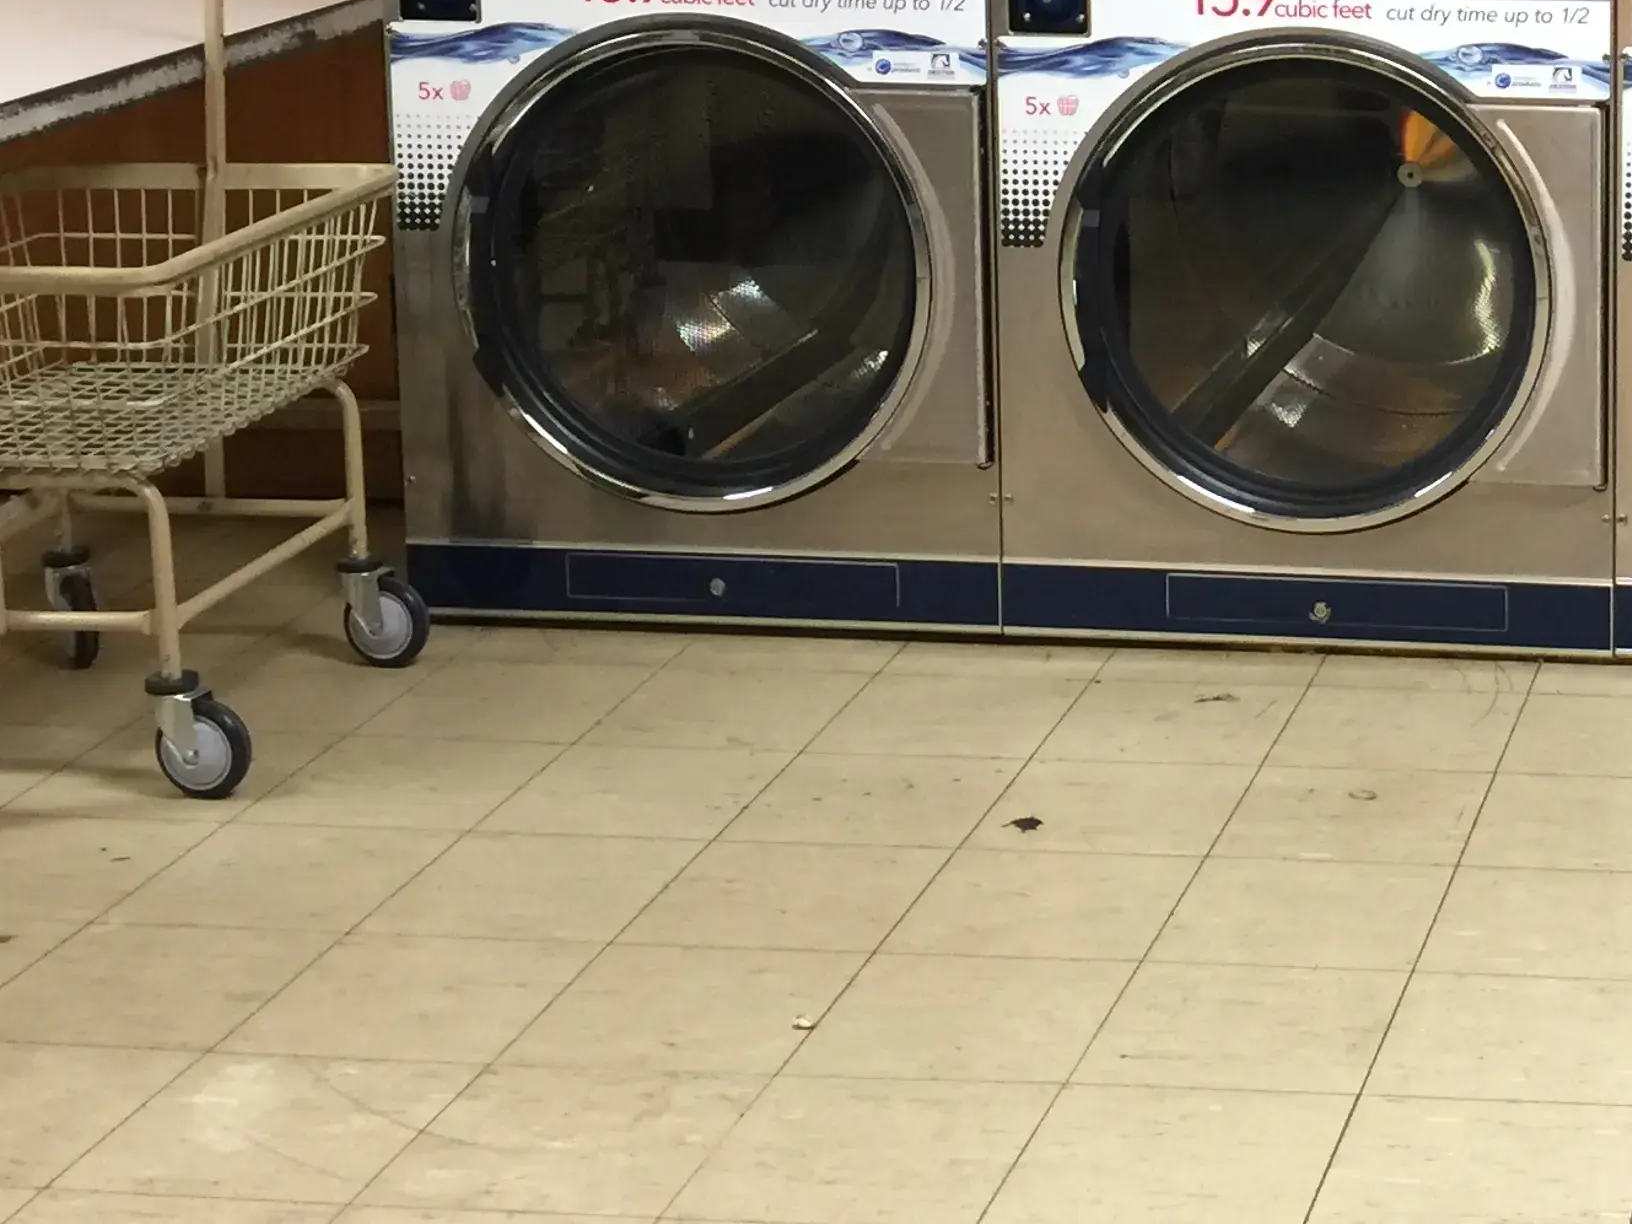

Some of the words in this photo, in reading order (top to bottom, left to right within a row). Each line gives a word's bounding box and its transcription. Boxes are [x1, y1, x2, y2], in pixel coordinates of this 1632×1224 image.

[884, 0, 907, 14] up
[1274, 1, 1329, 18] cubic
[1333, 3, 1372, 18] feet
[1387, 8, 1416, 20] cut
[1422, 6, 1452, 26] dry
[1458, 9, 1499, 22] time
[1506, 12, 1529, 27] up
[1536, 10, 1553, 23] to
[1562, 7, 1590, 24] 1/2
[419, 82, 444, 100] 5x
[1026, 96, 1049, 115] 5x
